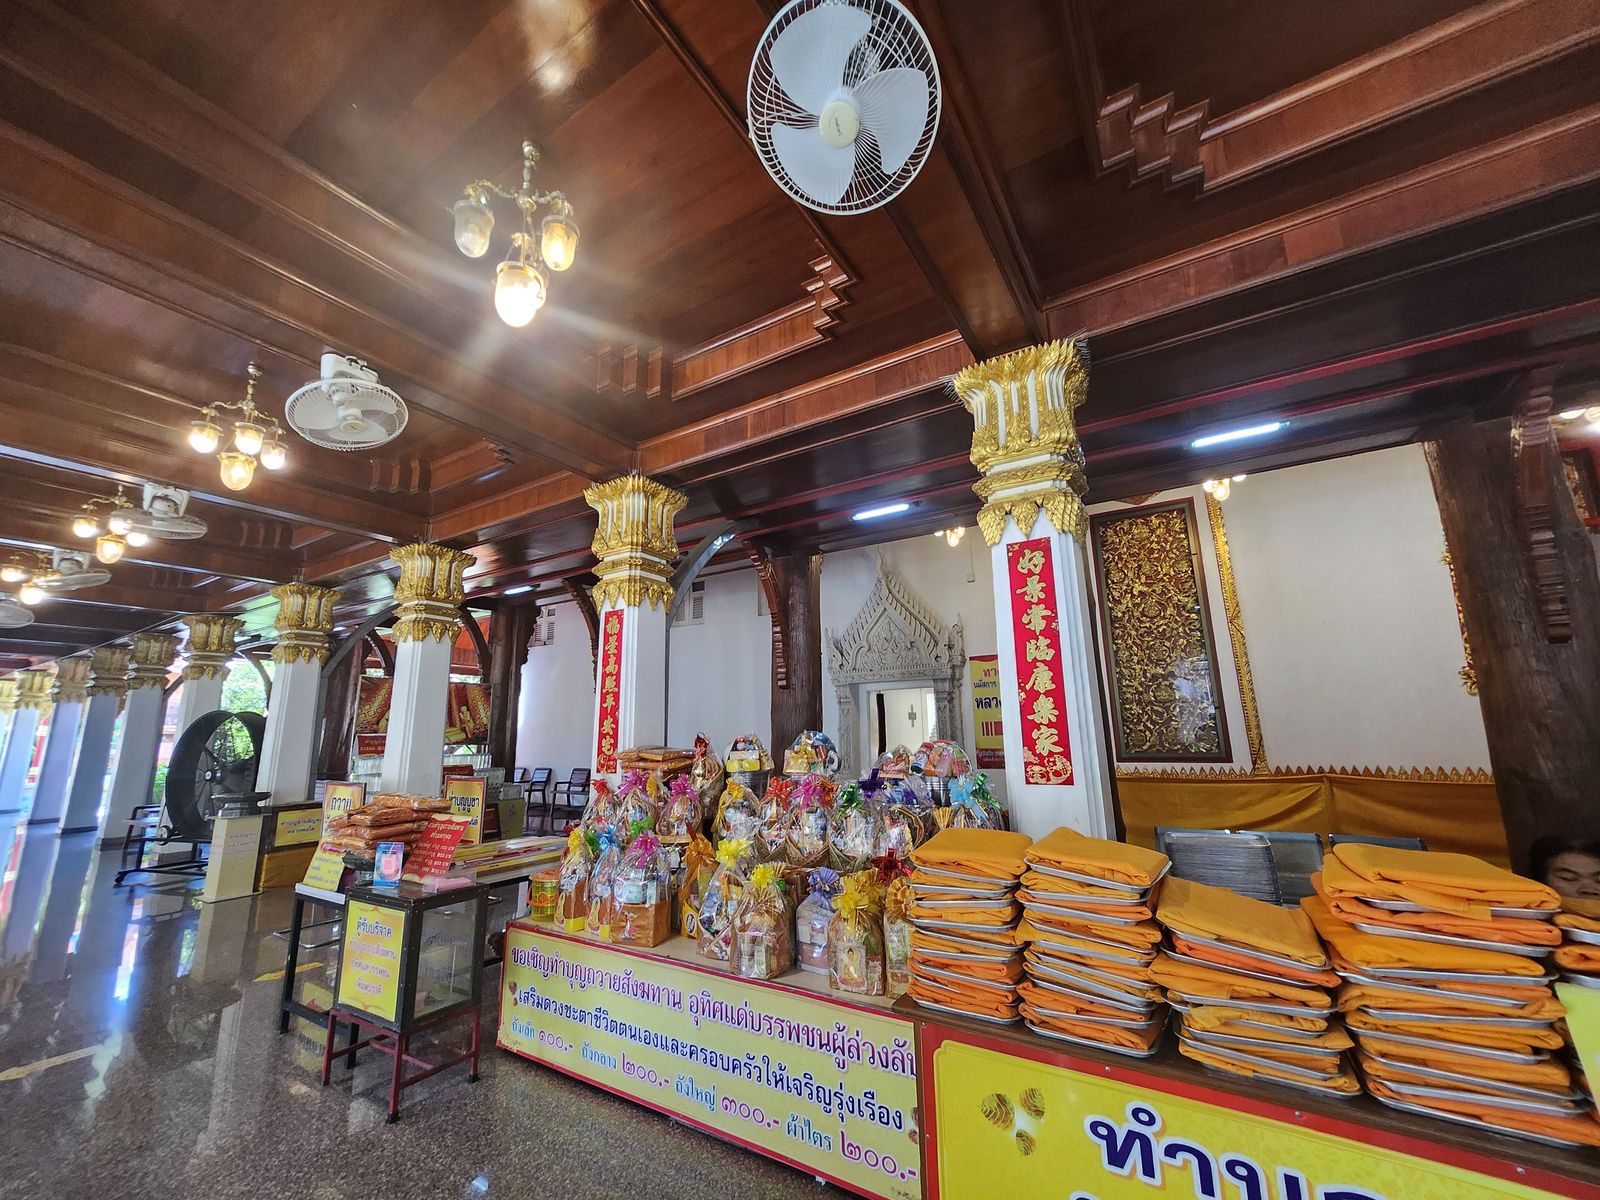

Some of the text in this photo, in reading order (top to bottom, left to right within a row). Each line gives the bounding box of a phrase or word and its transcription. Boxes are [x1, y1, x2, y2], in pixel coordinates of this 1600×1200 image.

[1016, 548, 1065, 755] 好景常臨康樂家
[356, 916, 392, 938] ตู้รับบริจาค
[511, 946, 683, 1010] ขอเชิญทำบุญถวายสังฆทาน
[511, 1017, 917, 1180] ถังเล็ก ๑๐๐.- ถังกลาง ๒๐๐.- ถังใหญ่ ๓๐๐.- ผ้าไตร ๒๐๐.-
[518, 986, 903, 1130] เสริมดวงชะตาชีวิตตนเองและครอบครัวให้เจริญรุ่งเรือง
